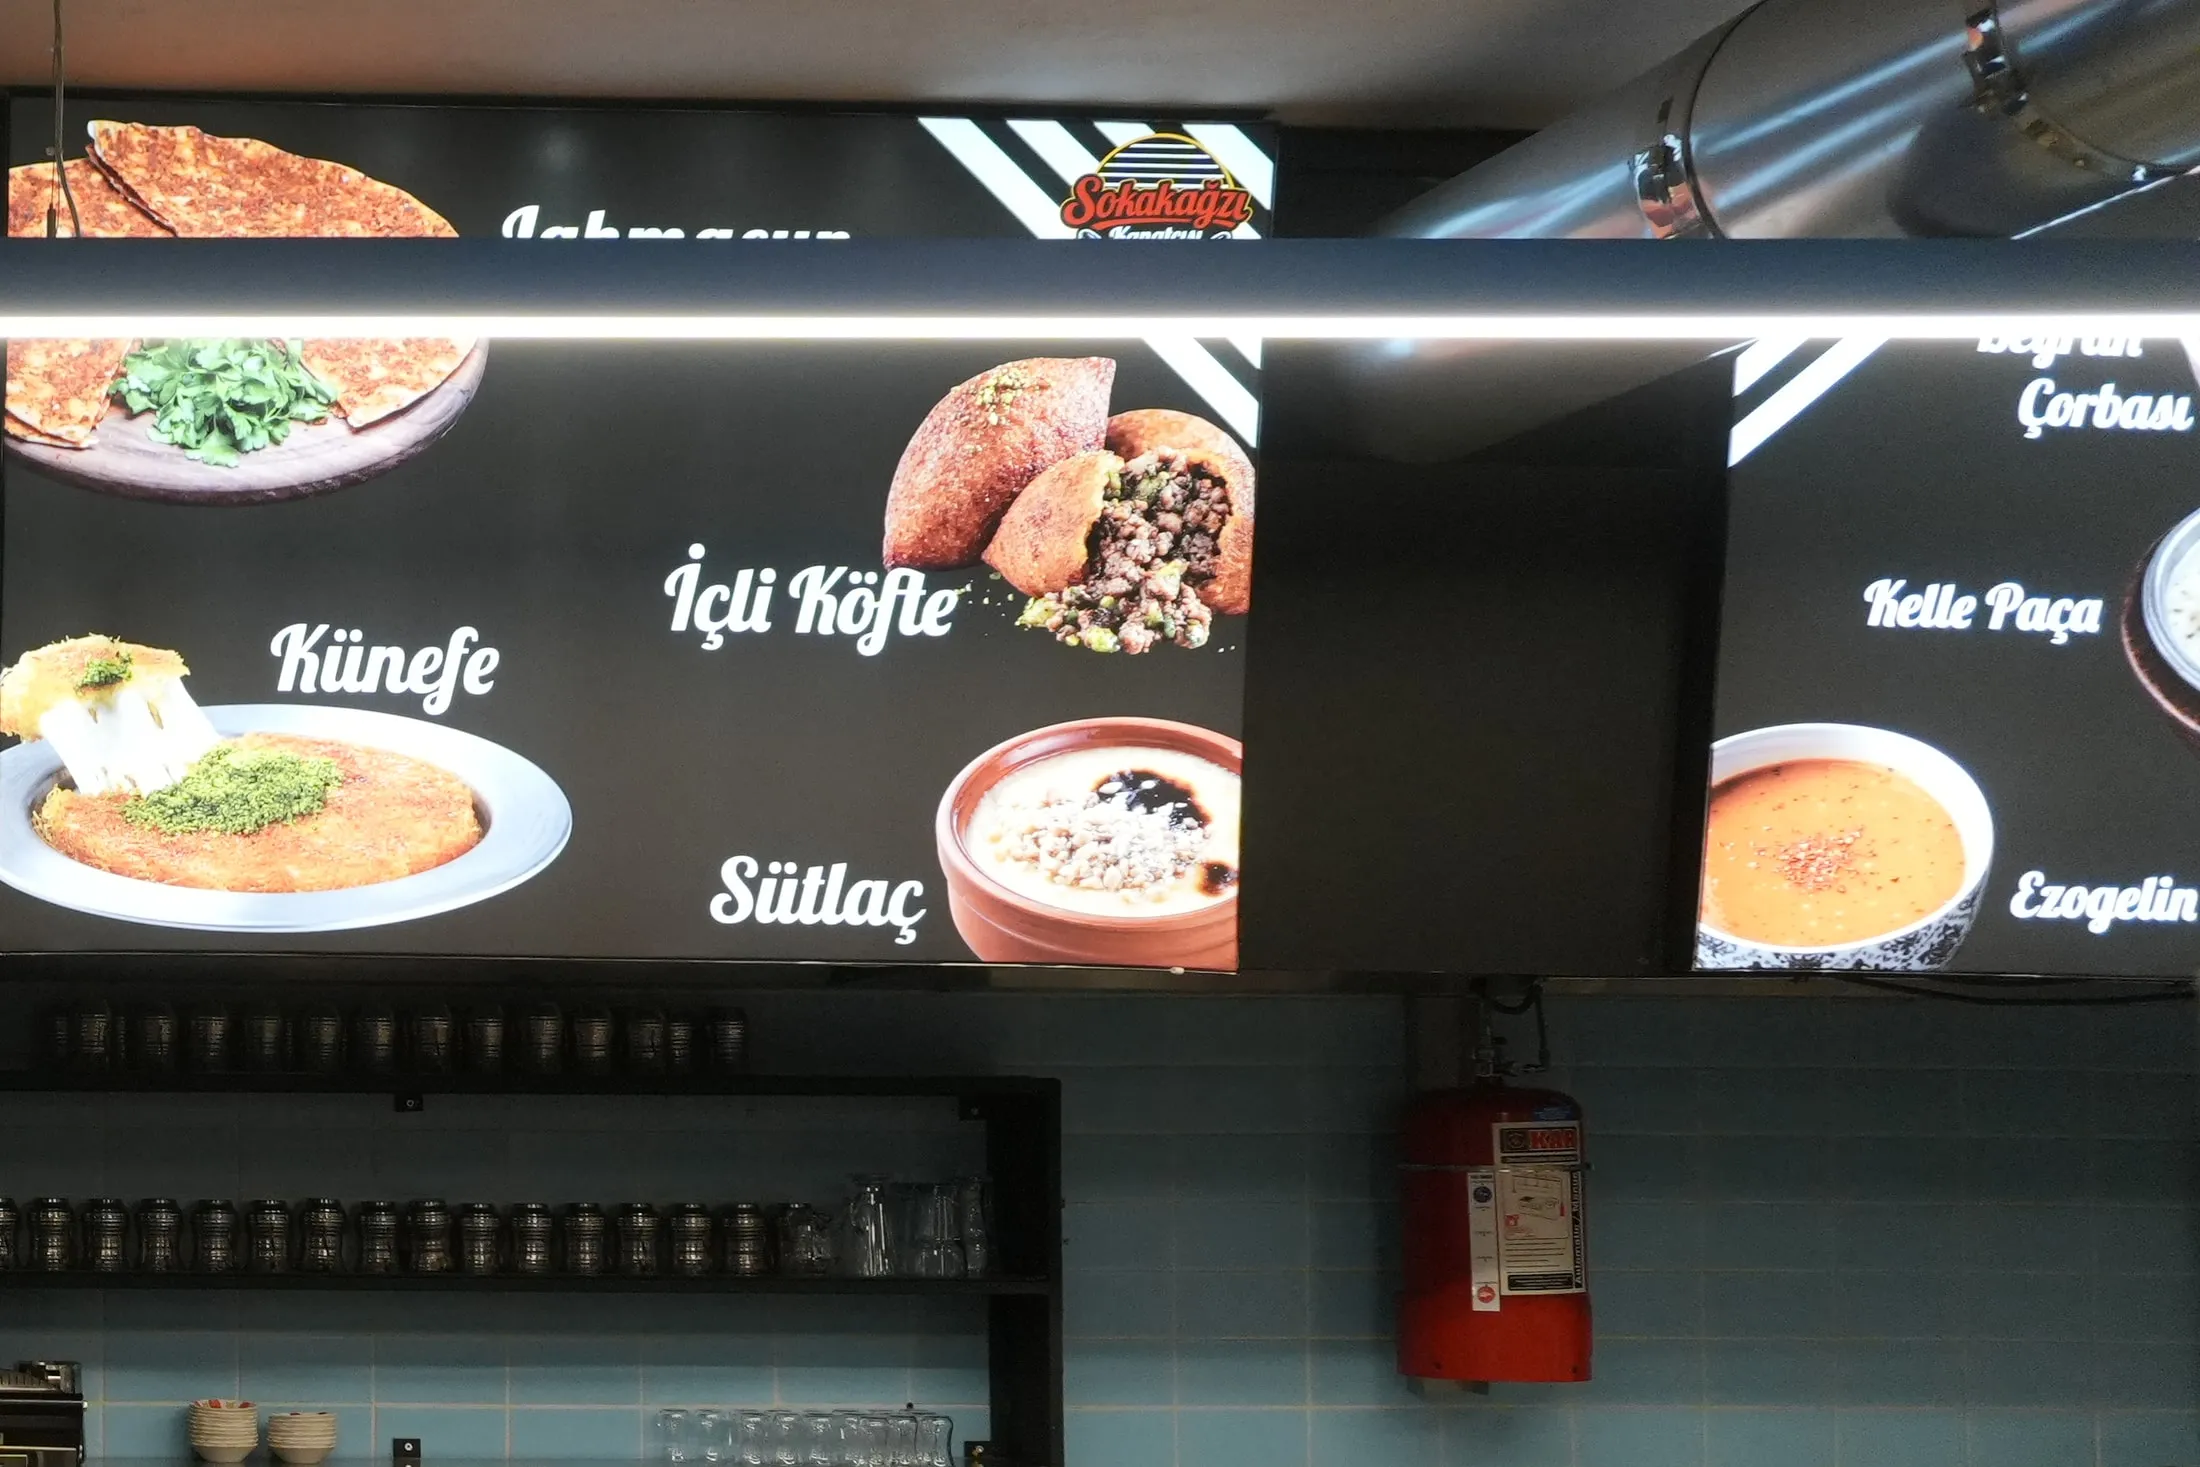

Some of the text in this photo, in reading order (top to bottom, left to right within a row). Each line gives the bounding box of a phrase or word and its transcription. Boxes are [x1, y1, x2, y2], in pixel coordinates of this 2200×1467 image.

[1062, 174, 1251, 229] Sokakağzı
[2017, 377, 2195, 438] Çorbası
[664, 543, 959, 657] İçli Köfte
[1863, 578, 2104, 645] Kelle Paça
[270, 622, 500, 716] Künefe
[709, 855, 927, 945] Sütlaç
[2009, 870, 2198, 934] Ezogelin
